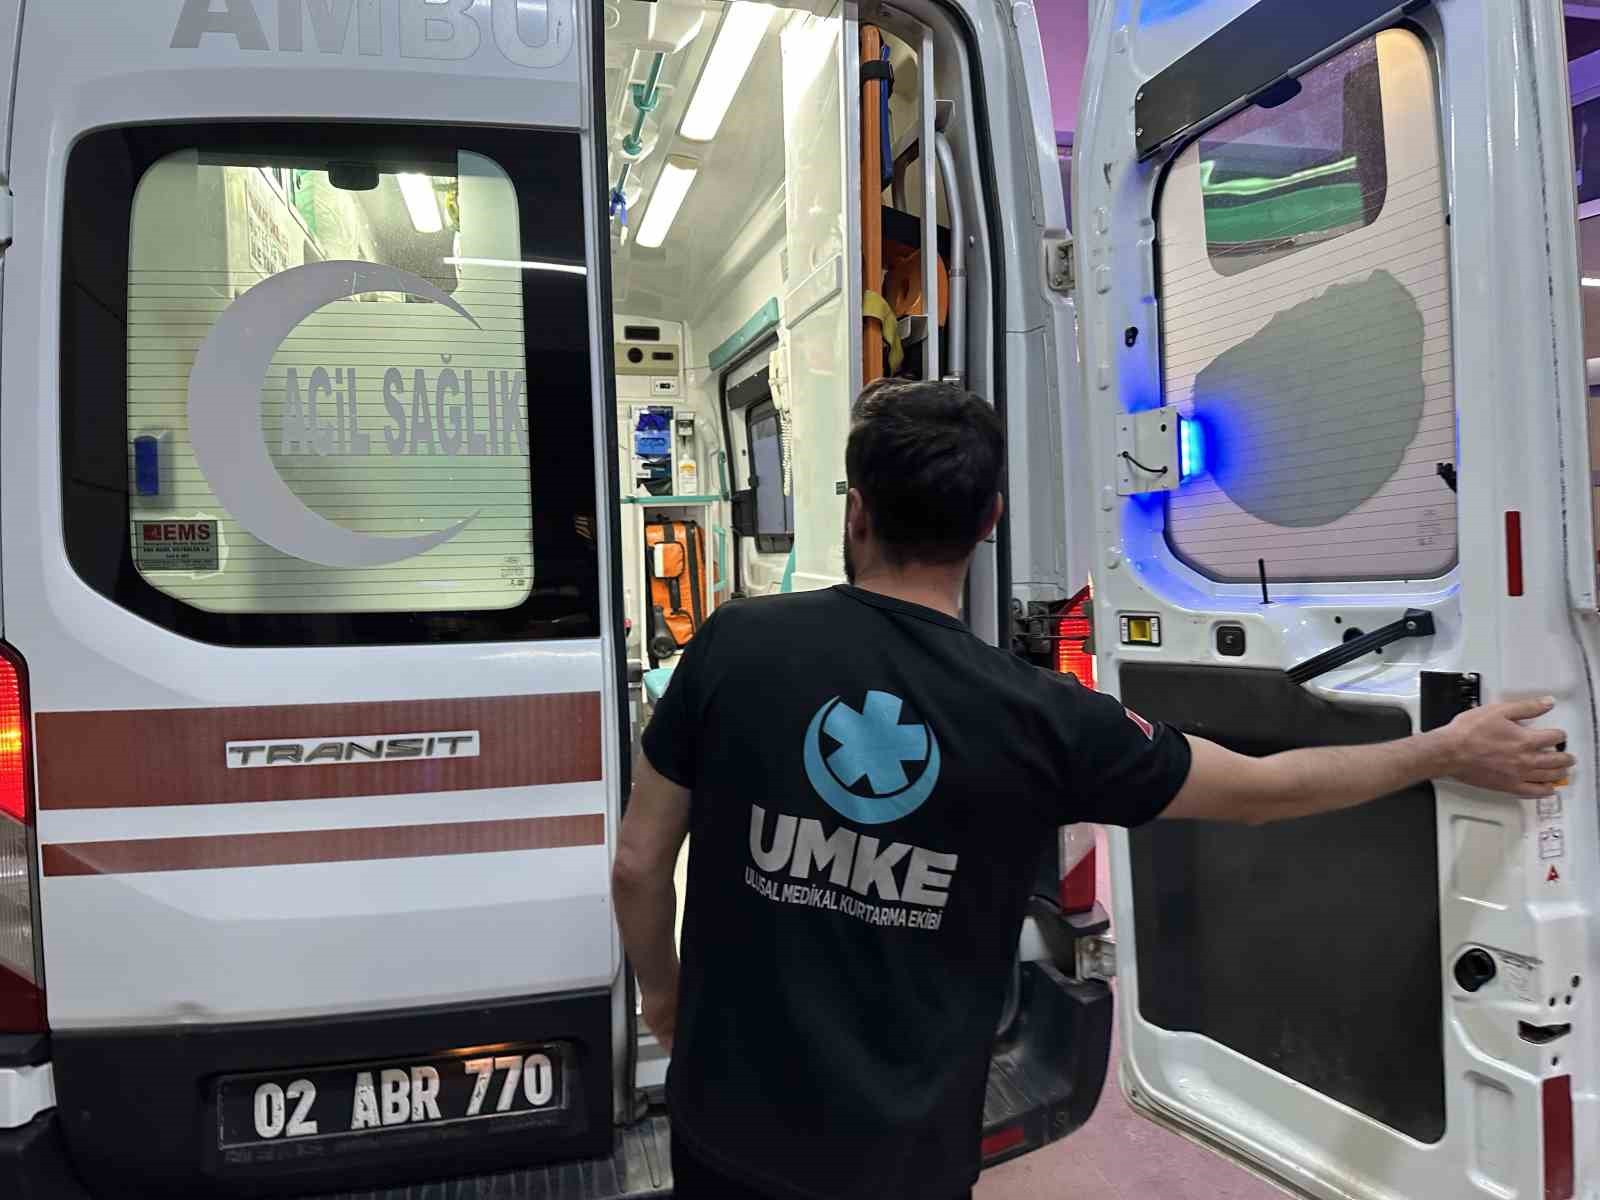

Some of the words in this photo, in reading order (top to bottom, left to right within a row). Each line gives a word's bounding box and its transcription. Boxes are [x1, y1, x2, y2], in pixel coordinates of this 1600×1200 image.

[383, 352, 528, 457] SAĞLIK
[163, 523, 209, 541] EMS
[229, 736, 473, 766] TRANSIT
[750, 803, 959, 908] UMKE
[744, 865, 780, 901] ULUSAL
[780, 882, 839, 911] MEDİKAL
[839, 894, 906, 927] KURTARMA
[907, 907, 943, 930] EKİBİ
[253, 1079, 318, 1139] 02
[350, 1065, 442, 1130] ABR
[464, 1053, 552, 1116] 770
